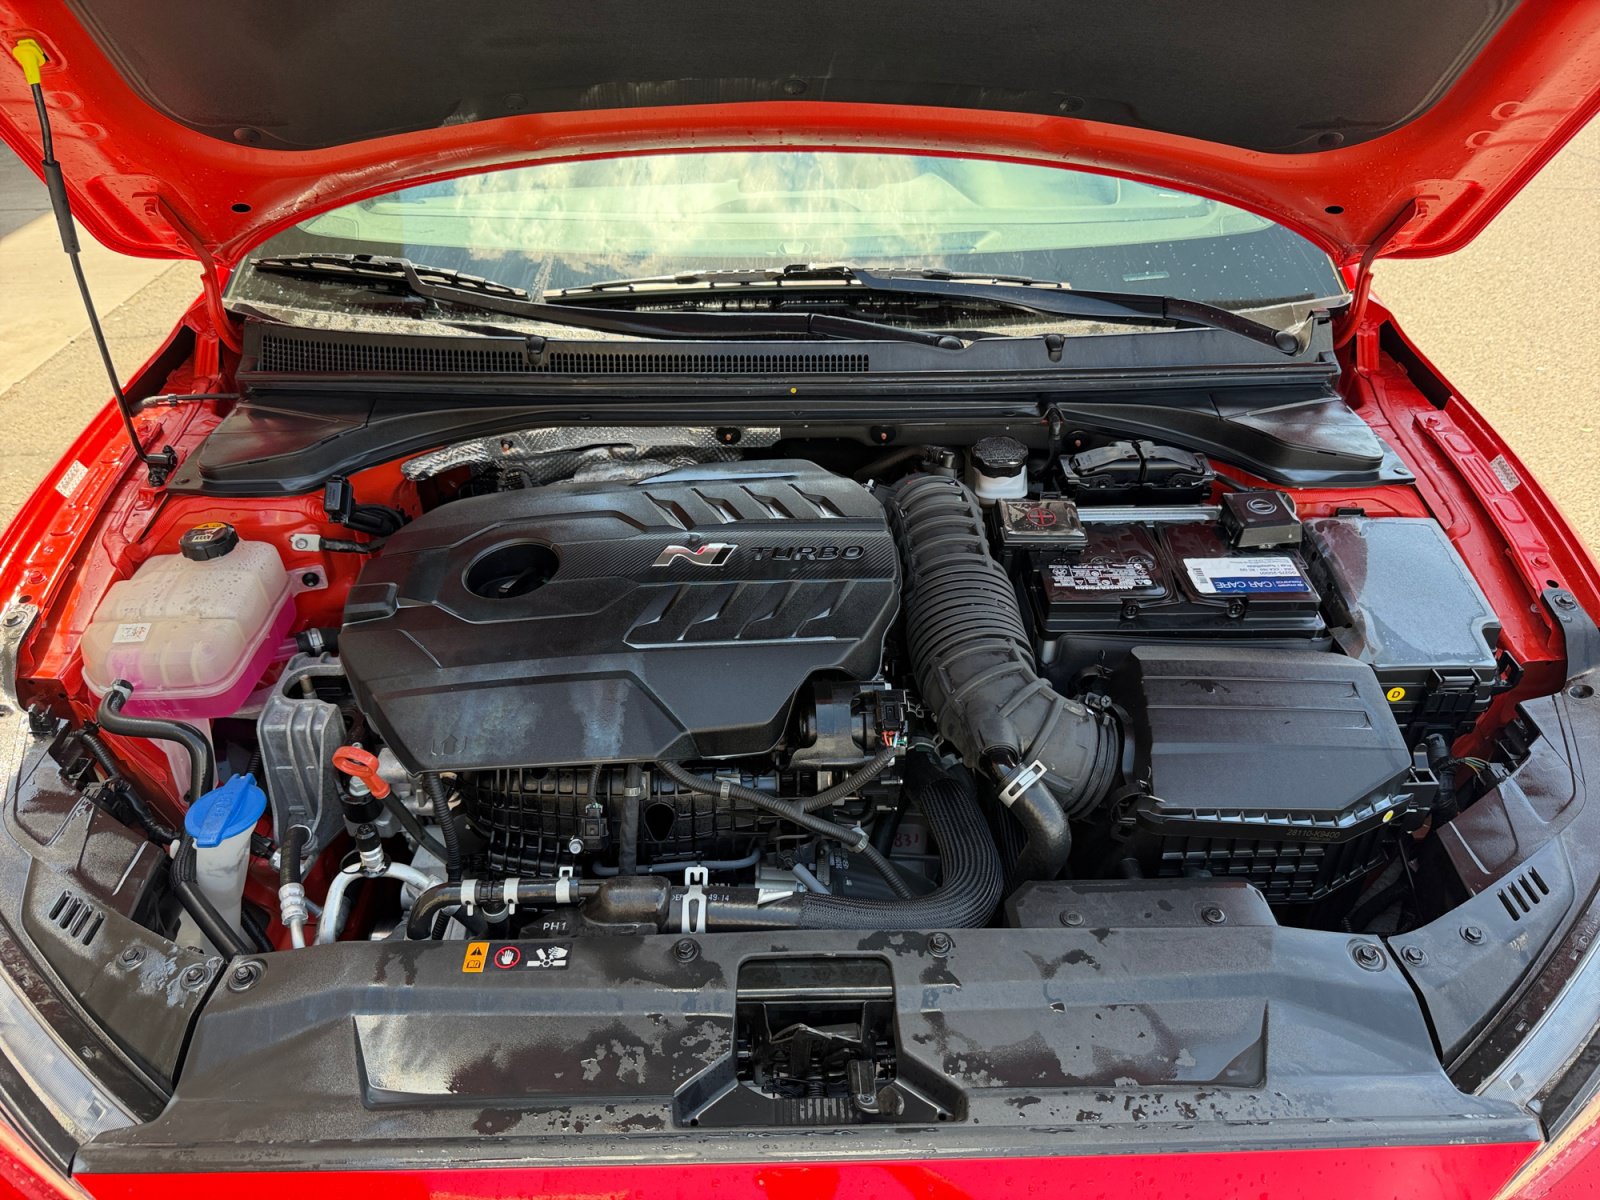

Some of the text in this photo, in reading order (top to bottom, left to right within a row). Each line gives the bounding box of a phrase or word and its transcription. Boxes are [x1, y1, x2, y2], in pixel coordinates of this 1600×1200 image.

[751, 545, 865, 561] TURBO
[1214, 581, 1246, 589] CARE
[1391, 690, 1401, 698] D
